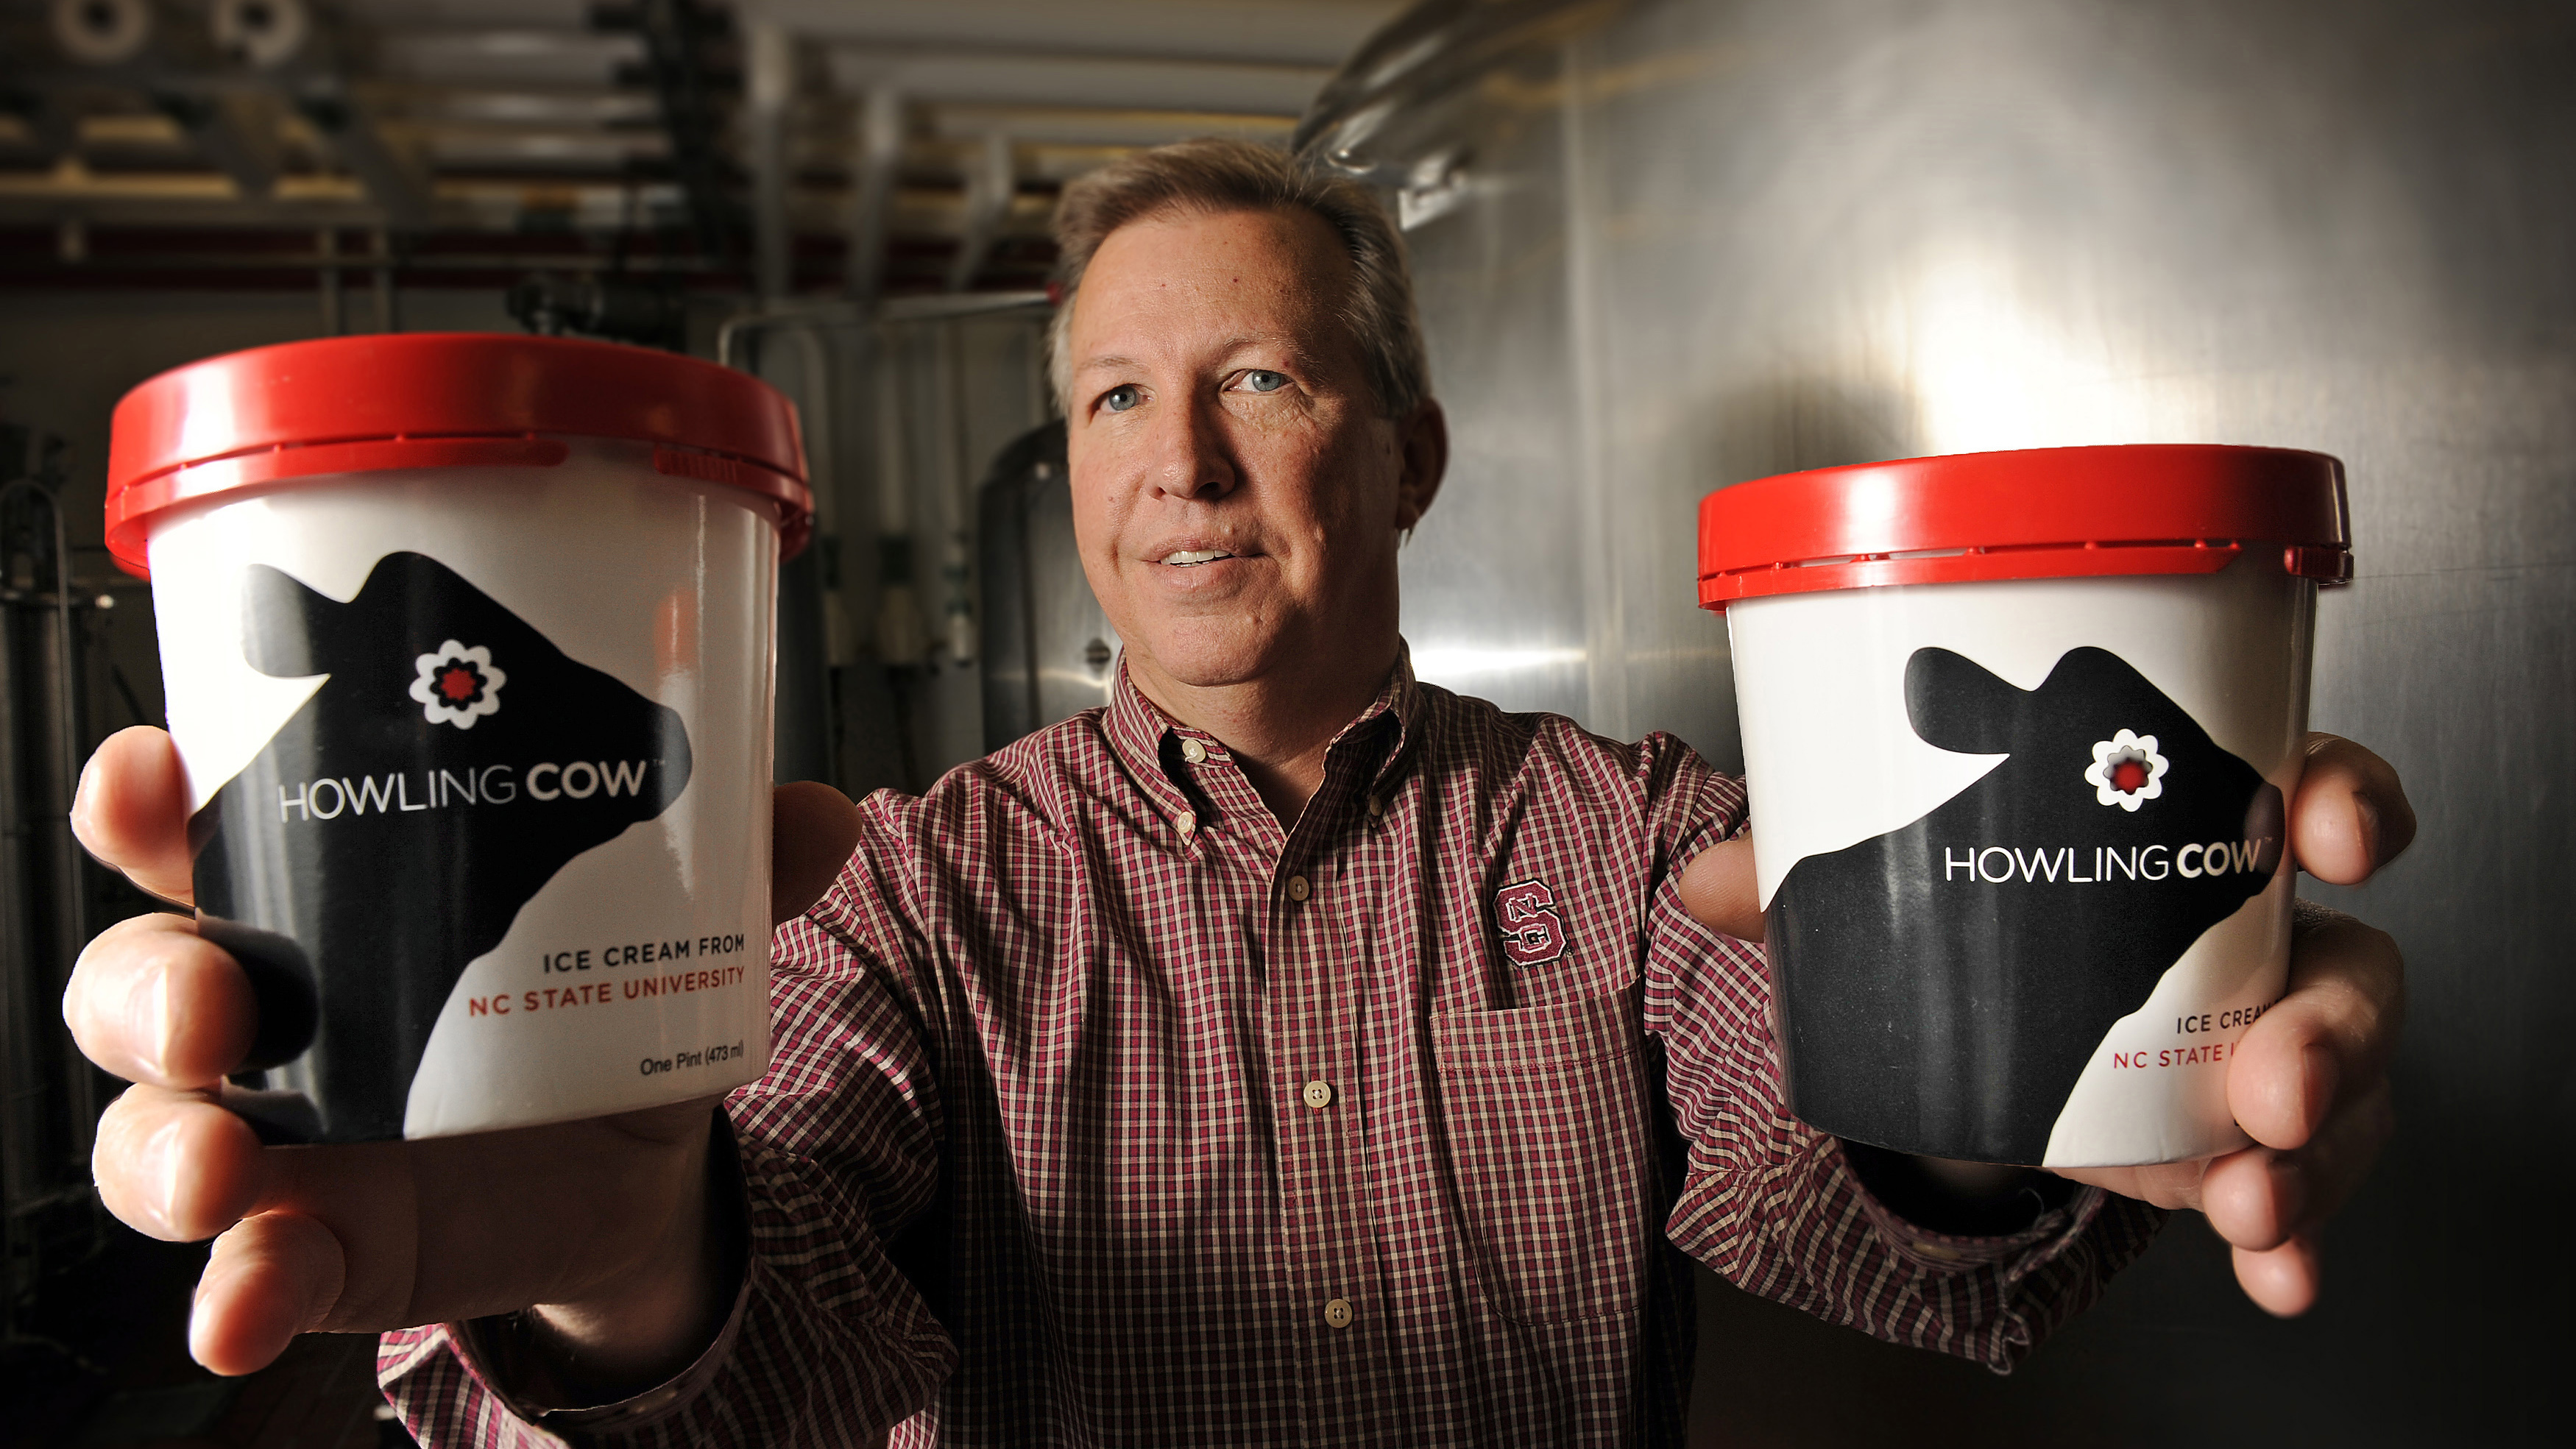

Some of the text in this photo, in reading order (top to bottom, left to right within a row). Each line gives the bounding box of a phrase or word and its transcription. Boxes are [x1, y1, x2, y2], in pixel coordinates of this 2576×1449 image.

[279, 759, 647, 822] HOWLING COW
[1945, 837, 2262, 882] HOWLING COW
[543, 934, 745, 974] ICE CREAM FROM
[469, 966, 745, 1016] NC STATE UNIVERSITY
[2177, 1014, 2212, 1034] ICE
[640, 1040, 744, 1076] One Pint (473 ml)
[2113, 1052, 2148, 1069] NC
[2158, 1044, 2223, 1067] STATE
